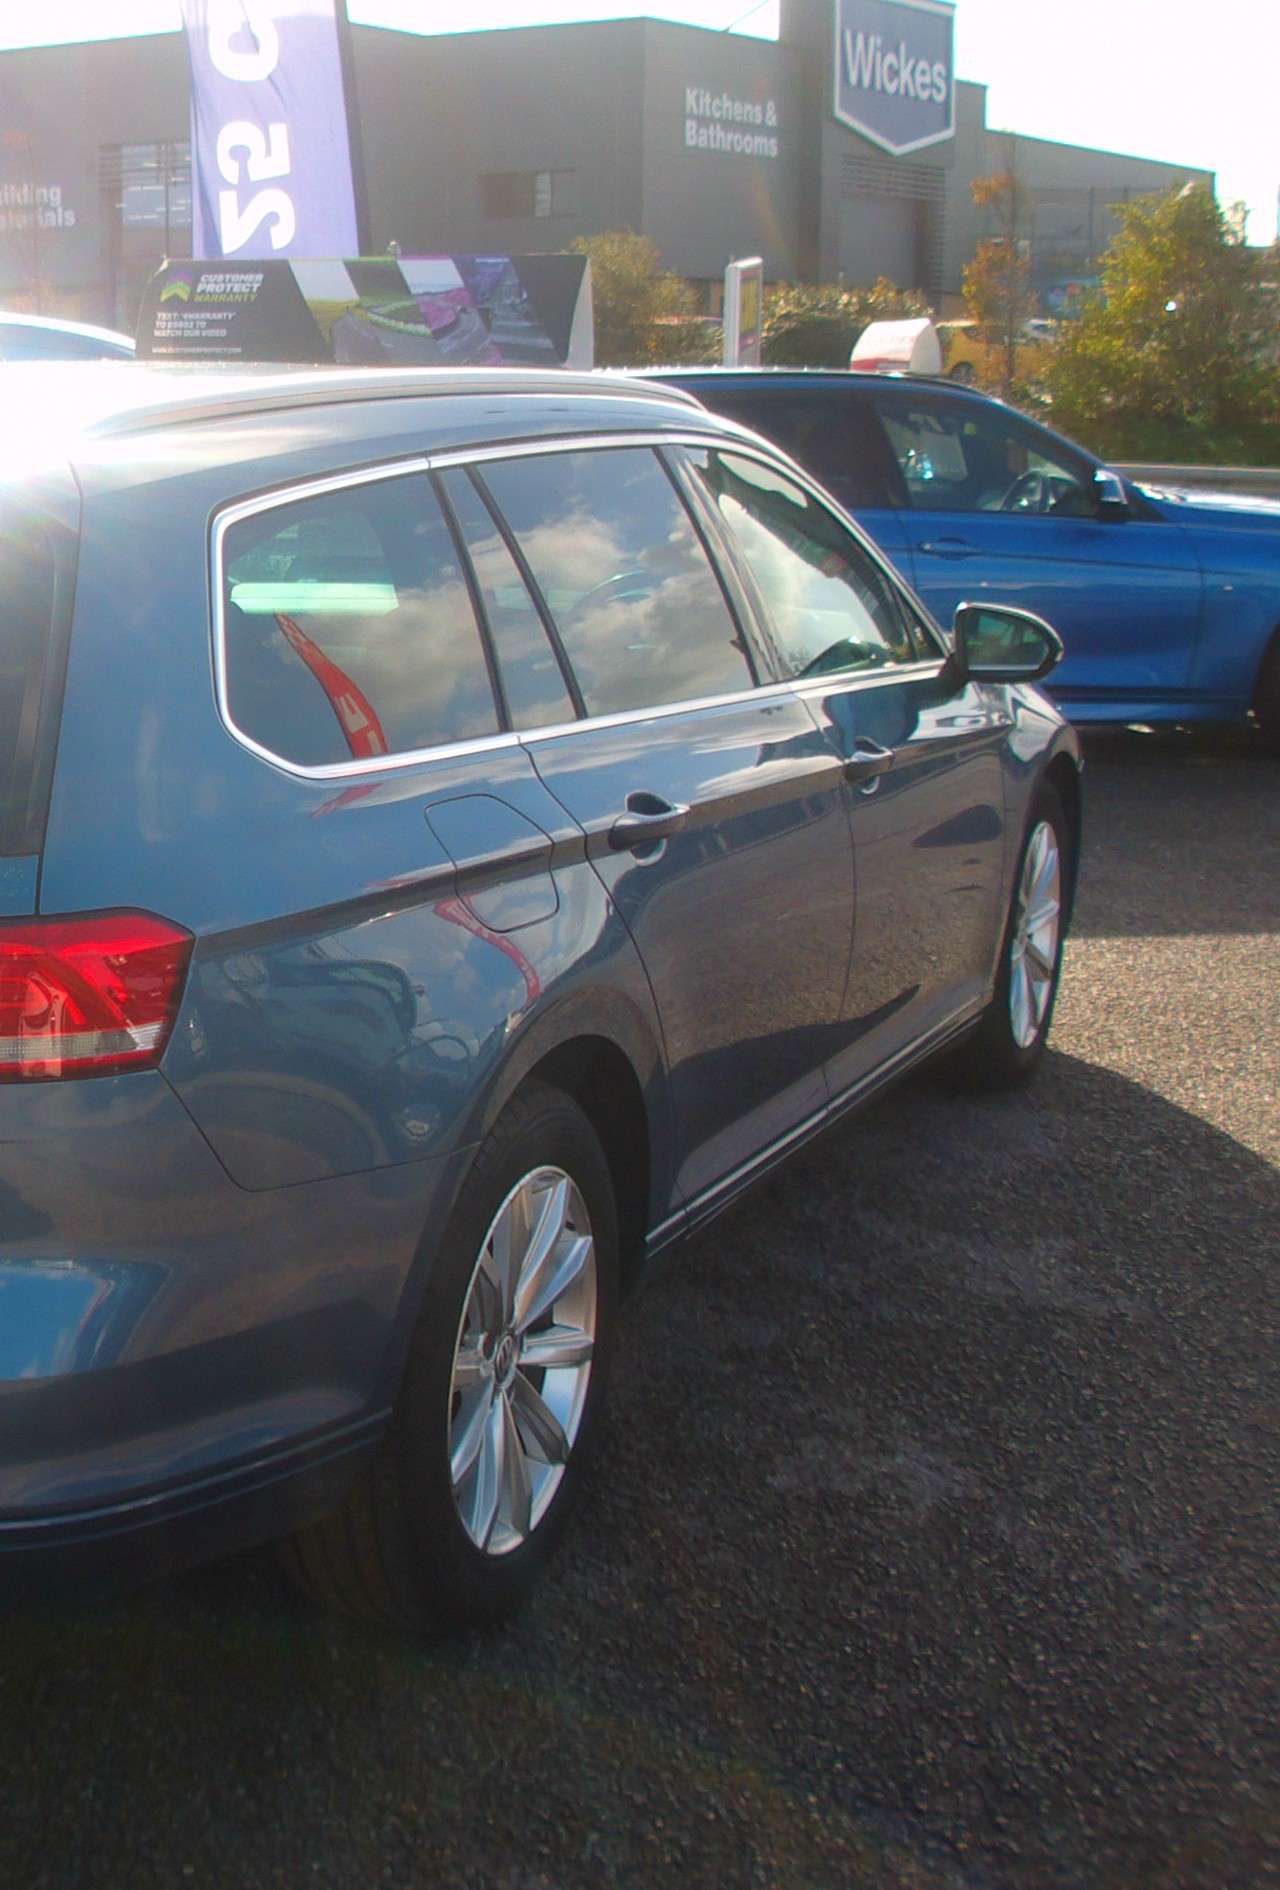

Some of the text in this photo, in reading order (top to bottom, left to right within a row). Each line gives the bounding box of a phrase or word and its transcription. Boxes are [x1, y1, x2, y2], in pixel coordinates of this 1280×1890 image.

[844, 28, 948, 103] Wickes
[685, 87, 778, 127] Kitchens &
[685, 119, 779, 158] Bathrooms
[196, 283, 261, 293] PROTECT
[200, 273, 265, 283] CUSTOMER
[194, 293, 258, 302] WARRANTY
